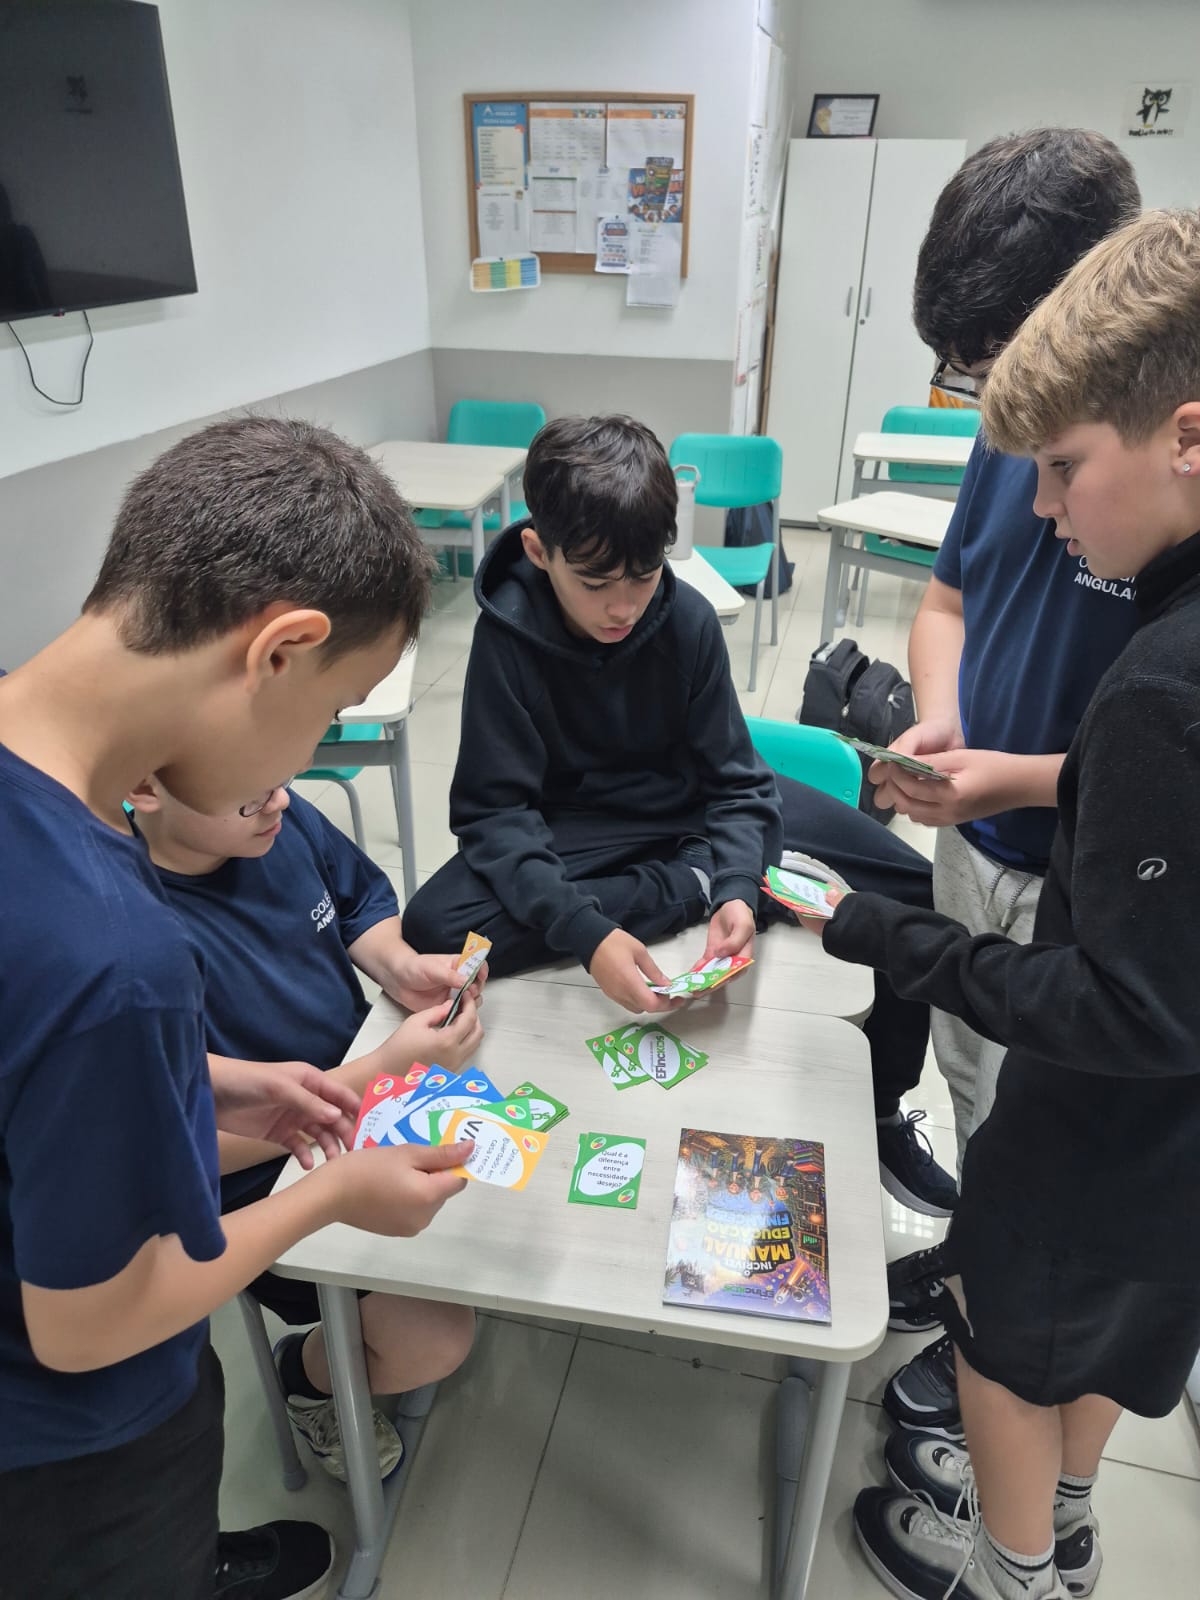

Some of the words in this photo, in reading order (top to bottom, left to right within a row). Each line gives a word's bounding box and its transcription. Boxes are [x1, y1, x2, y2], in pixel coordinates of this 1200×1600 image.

[598, 1157, 629, 1167] diferença
[587, 1171, 628, 1181] necessidade
[704, 1236, 791, 1261] MANUAL
